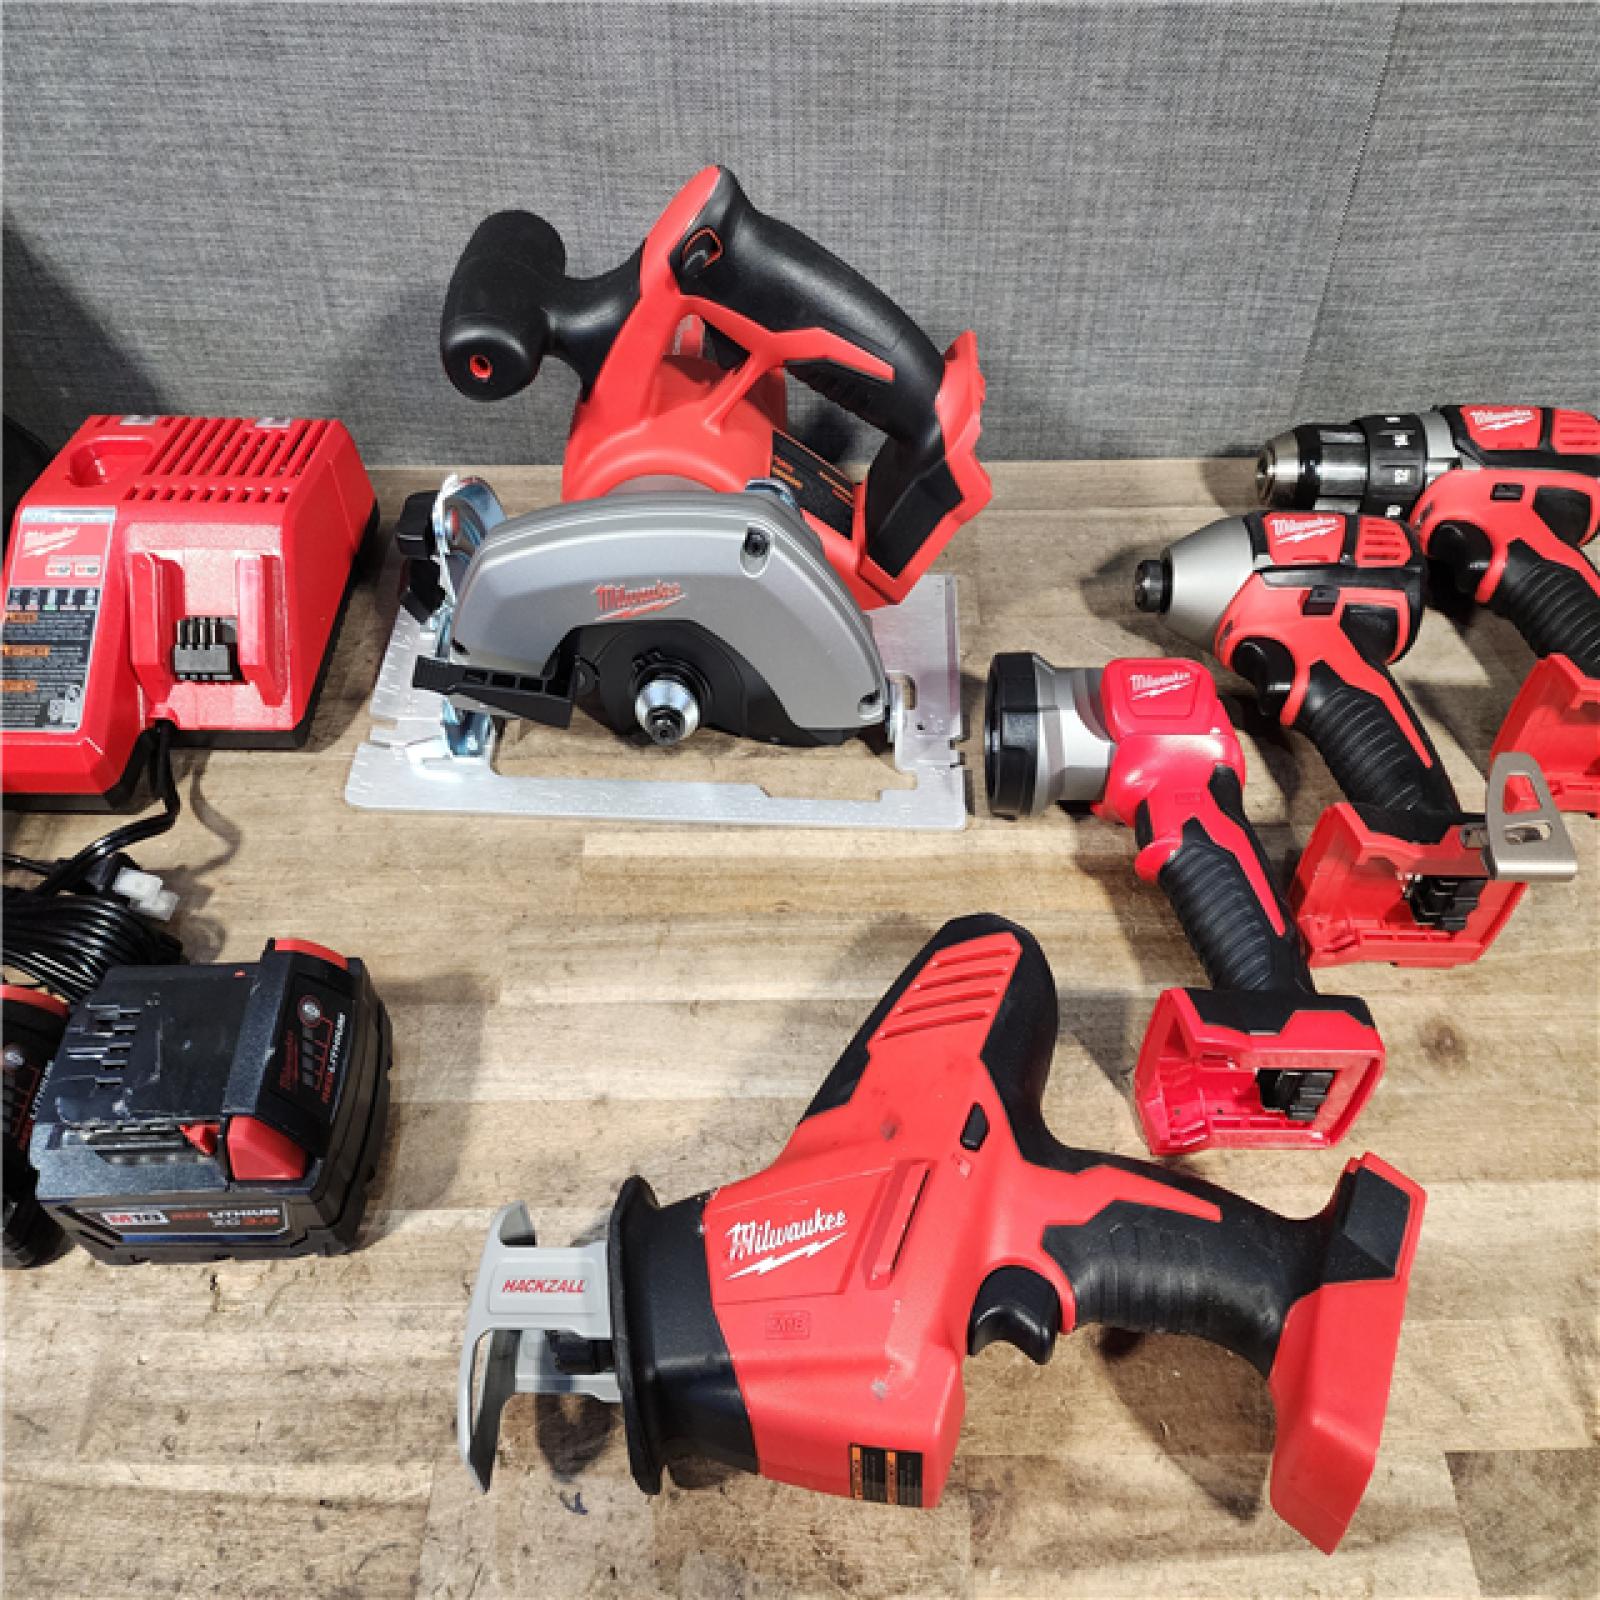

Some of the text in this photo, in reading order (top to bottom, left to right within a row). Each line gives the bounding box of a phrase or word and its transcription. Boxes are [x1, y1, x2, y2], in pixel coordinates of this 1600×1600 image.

[592, 579, 682, 611] Milwaukee
[725, 1206, 848, 1262] Milwaukee
[501, 1279, 586, 1294] HACKZALL
